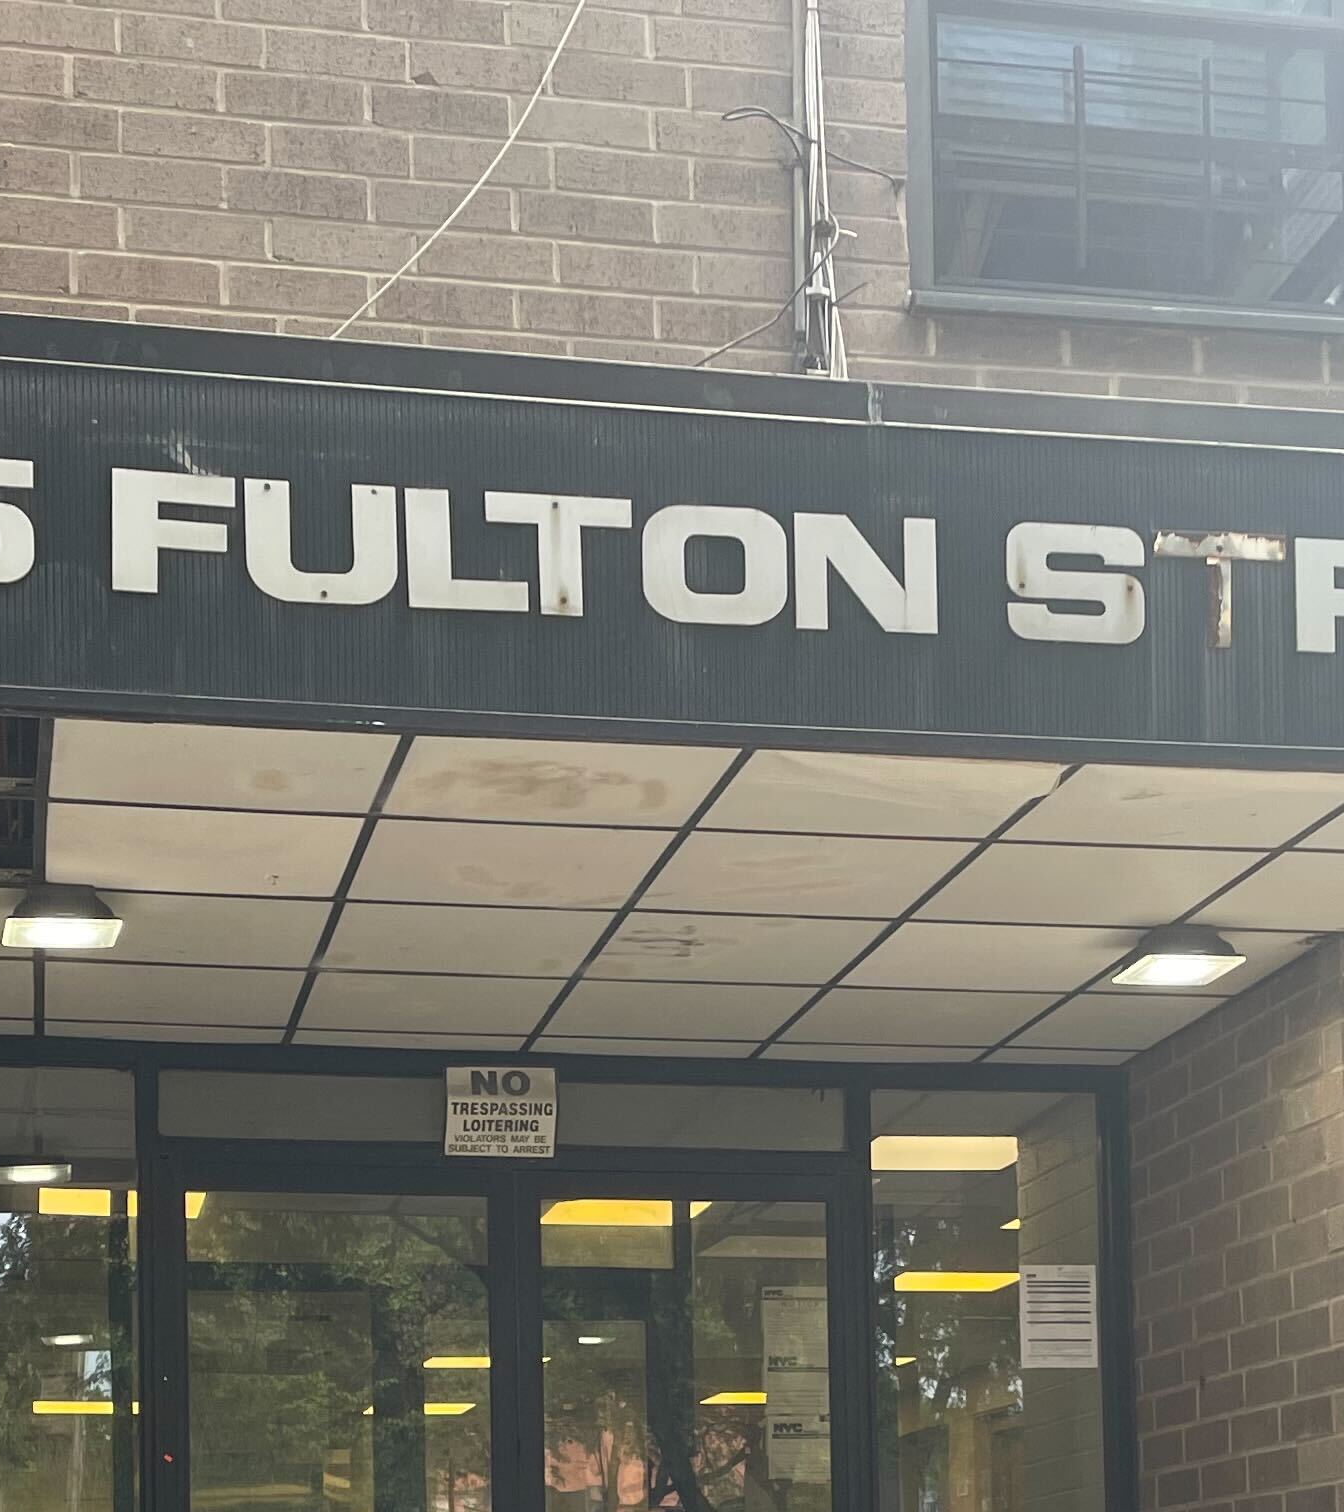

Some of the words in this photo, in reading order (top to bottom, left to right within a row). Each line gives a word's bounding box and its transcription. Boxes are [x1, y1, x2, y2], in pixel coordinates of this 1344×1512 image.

[112, 465, 939, 636] FULTON
[470, 1070, 531, 1096] NO
[451, 1102, 553, 1116] TRESPASSING
[463, 1119, 539, 1132] LOITERING
[454, 1135, 506, 1143] VIOLATORS
[510, 1135, 530, 1143] MAY
[448, 1144, 491, 1153] SUBJECT
[497, 1145, 509, 1153] TO
[513, 1145, 551, 1154] ARREST
[773, 1423, 803, 1433] NYC
